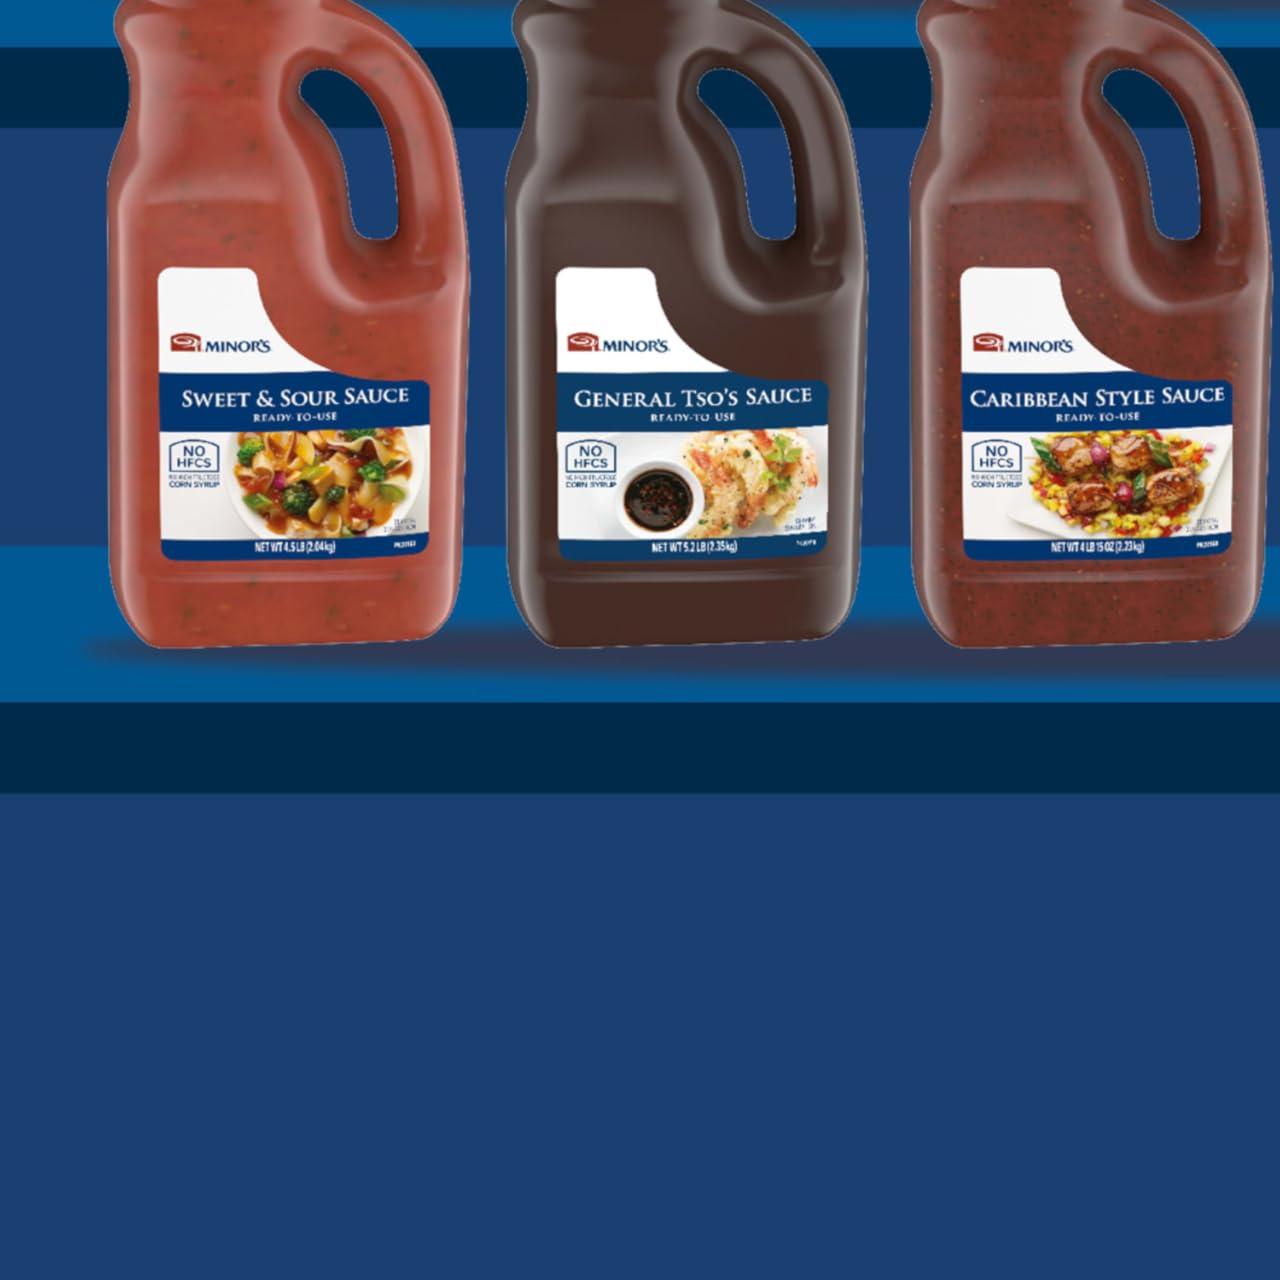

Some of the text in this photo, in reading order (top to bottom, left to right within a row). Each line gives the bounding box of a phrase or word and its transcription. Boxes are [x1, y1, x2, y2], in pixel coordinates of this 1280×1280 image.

[205, 339, 271, 353] MINOR'S
[603, 339, 668, 353] MINOR'S
[1008, 339, 1073, 353] MINOR'S
[182, 388, 409, 407] SWEET & SOUR SAUCE
[574, 388, 812, 407] GENERAL TSO'S SAUCE
[970, 387, 1225, 407] CARIBBEAN STYLE SAUCE
[183, 446, 205, 456] NO
[579, 446, 602, 456] NO
[986, 446, 1008, 456] NO
[177, 457, 211, 468] HFCS
[574, 457, 608, 468] HFCS
[980, 457, 1014, 468] HFCS
